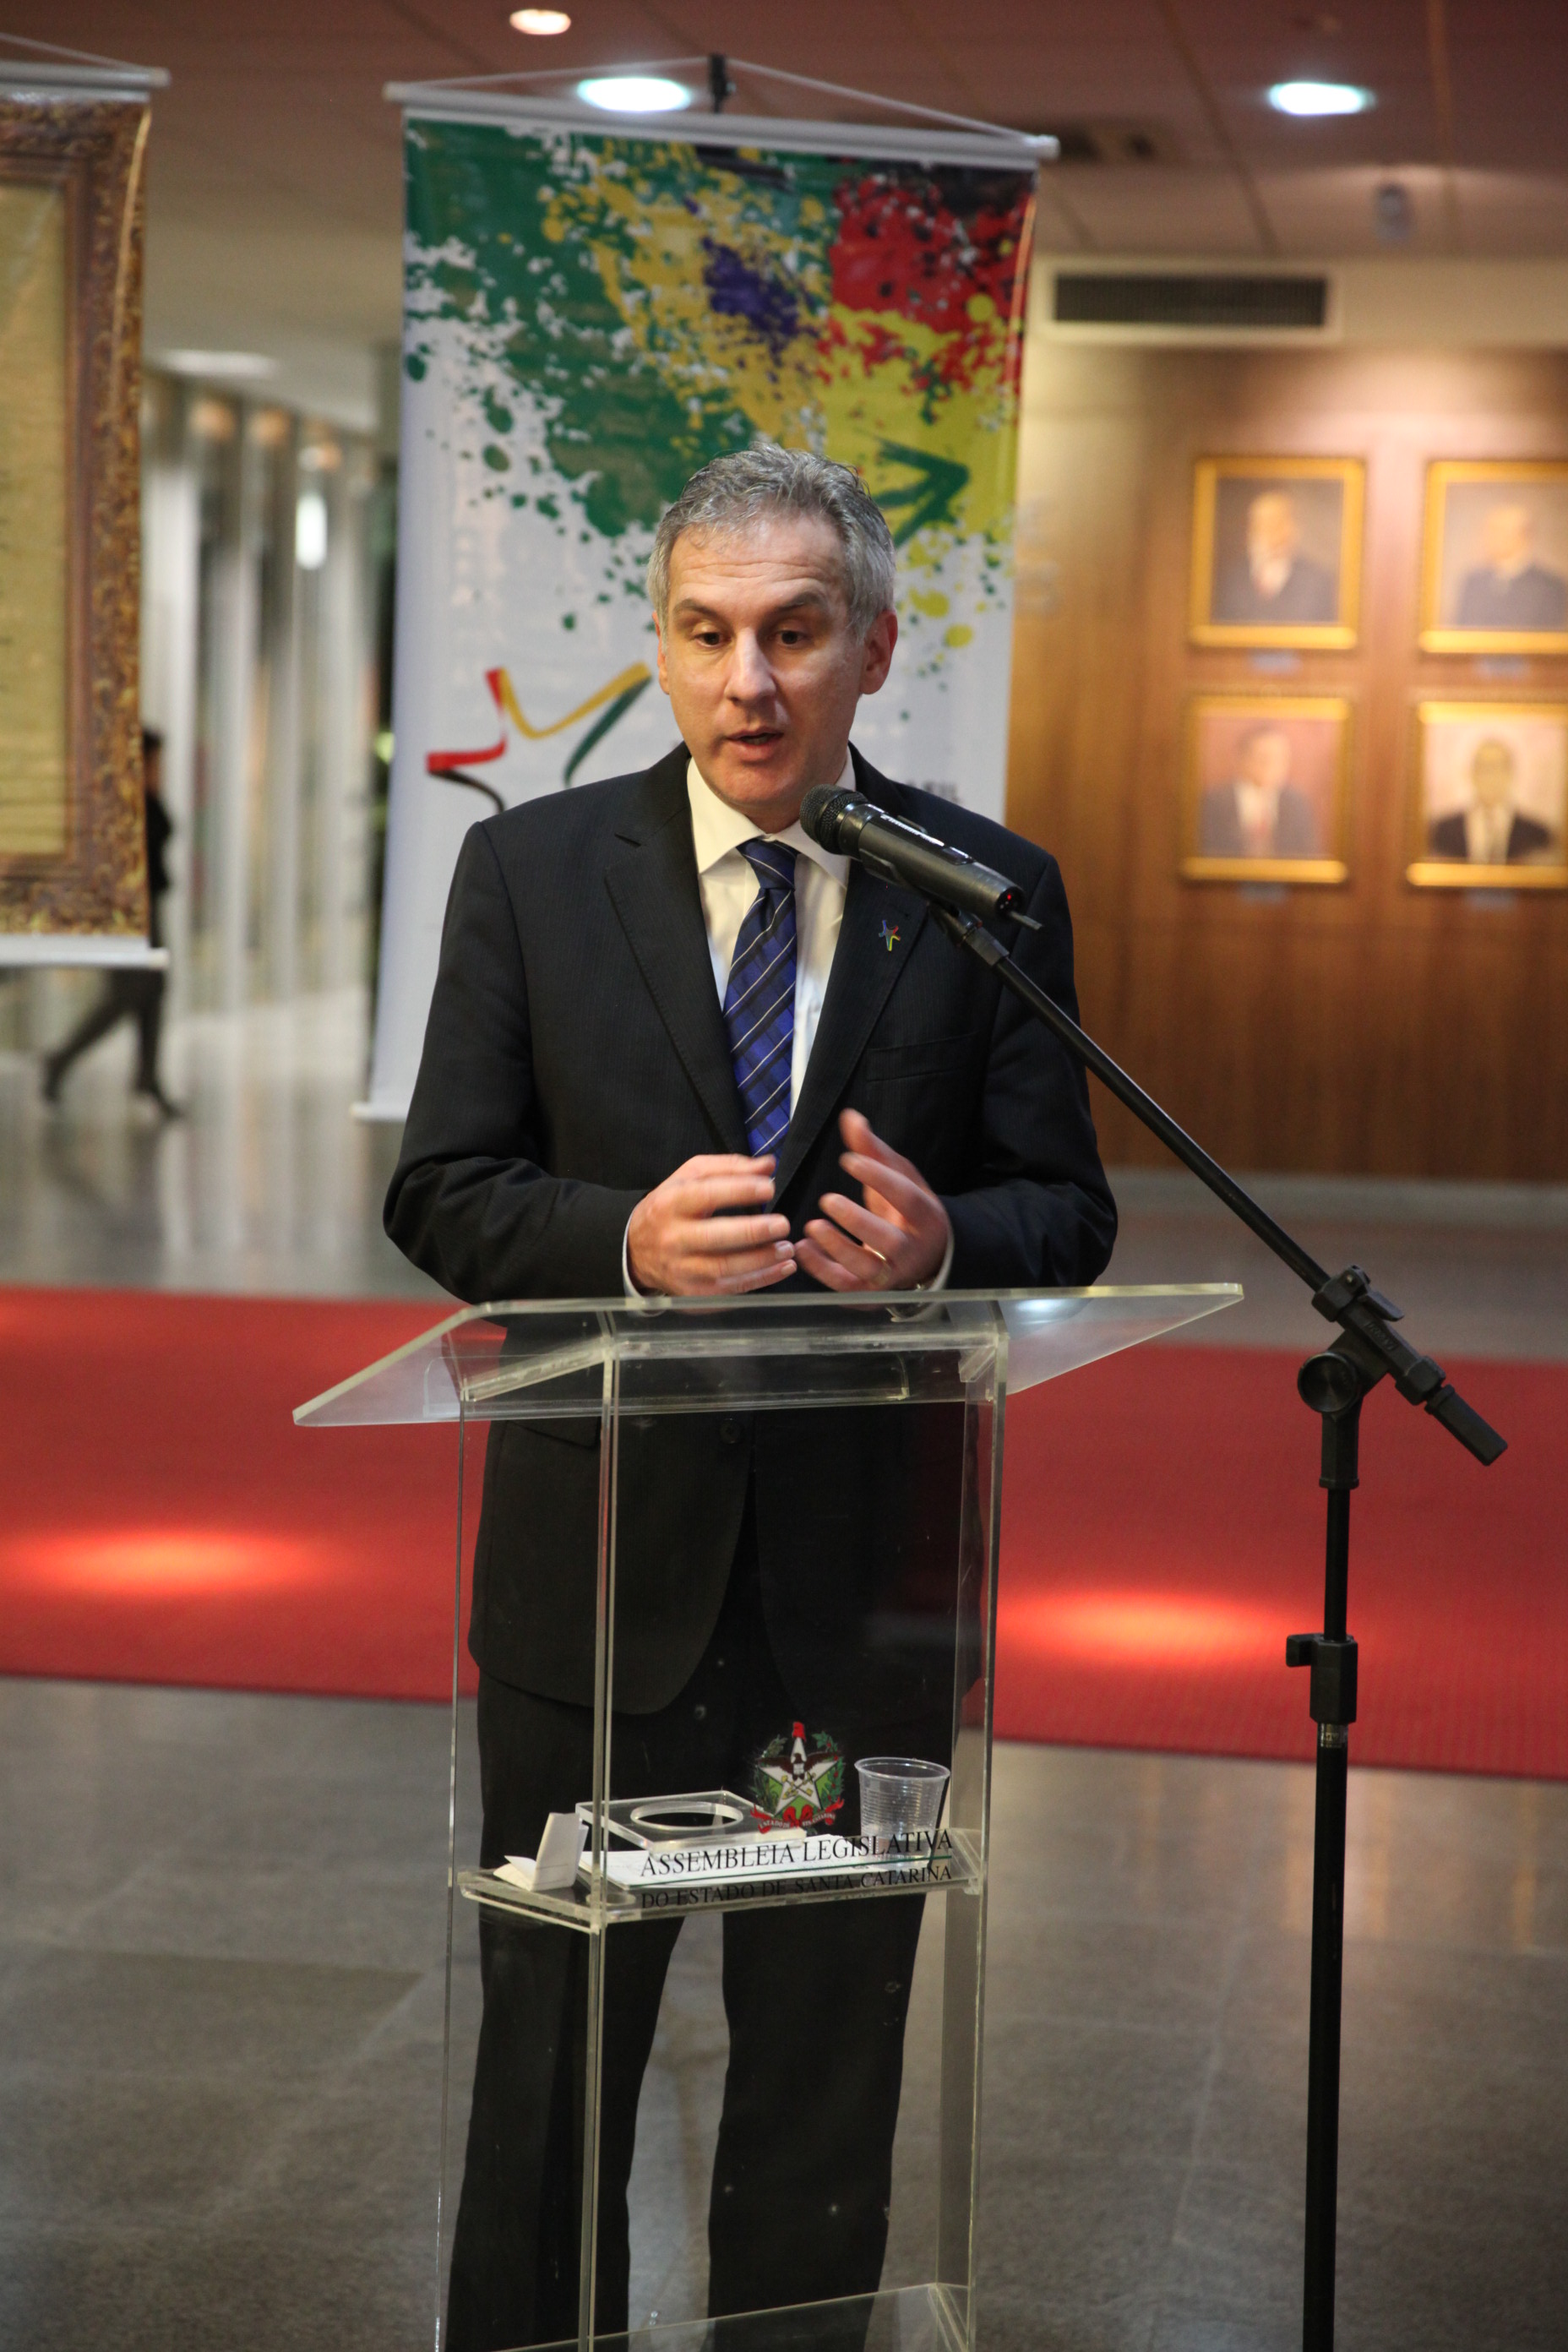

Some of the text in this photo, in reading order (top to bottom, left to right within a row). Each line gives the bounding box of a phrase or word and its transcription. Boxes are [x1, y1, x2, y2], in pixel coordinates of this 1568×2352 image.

[640, 1829, 952, 1876] ASSEMBLEIA LEGISLATIVA
[642, 1865, 952, 1908] DO ESTADO DE SANTA CATARINA
